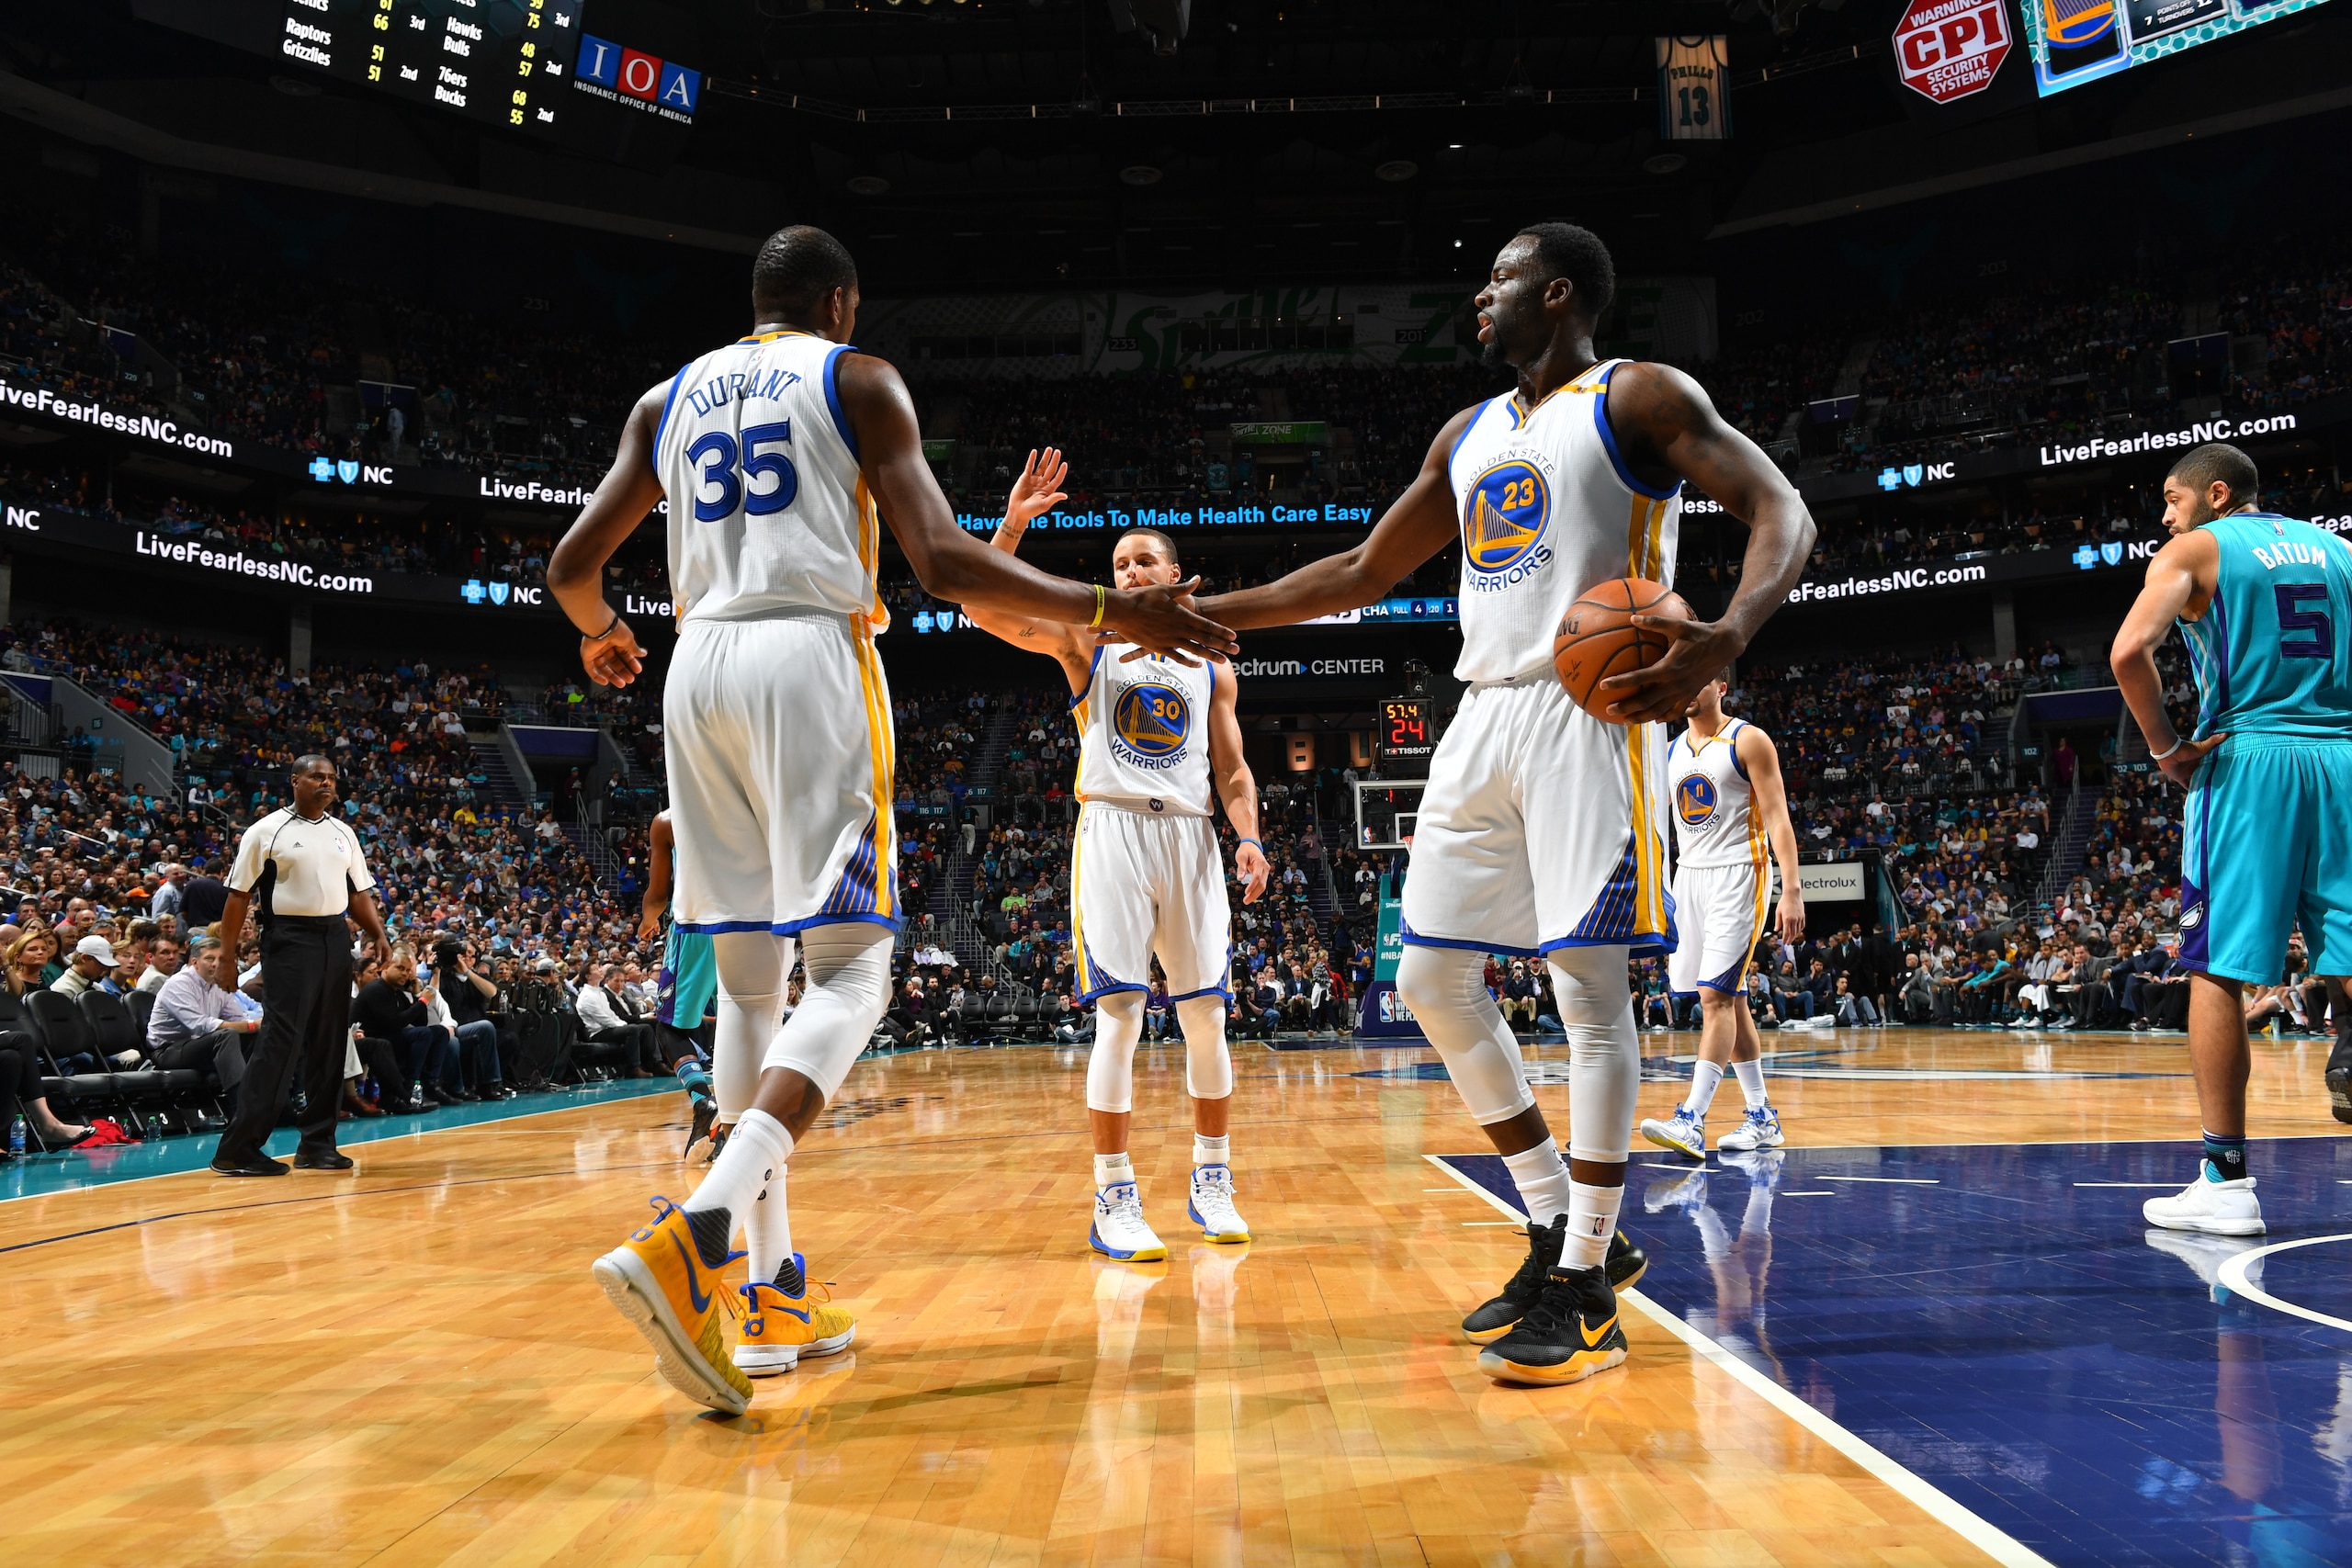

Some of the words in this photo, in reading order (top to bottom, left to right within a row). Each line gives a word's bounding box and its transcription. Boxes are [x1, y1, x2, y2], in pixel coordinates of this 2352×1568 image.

[2144, 16, 2153, 26] 7
[2157, 6, 2195, 24] TURNOVERS
[2156, 3, 2179, 16] POINTS
[286, 17, 332, 45] Raptors
[373, 14, 389, 30] 66
[410, 15, 425, 31] 3rd
[447, 17, 482, 40] Hawks
[527, 12, 540, 28] 75
[554, 13, 570, 28] 3rd
[443, 36, 470, 57] Bulls
[521, 41, 536, 58] 48
[1903, 6, 2003, 70] CPI
[283, 39, 331, 66] Grizzlies
[371, 45, 384, 62] 51
[368, 65, 381, 82] 51
[400, 65, 418, 81] 2nd
[438, 65, 468, 87] 76ers
[518, 61, 533, 77] 57
[545, 61, 562, 76] 2nd
[1670, 65, 1713, 80] PHILLS
[1927, 53, 1988, 85] SECURITY
[1931, 66, 1990, 96] SYSTEMS
[435, 85, 466, 107] Bucks
[512, 89, 527, 106] 68
[573, 80, 616, 101] INSURANCE
[619, 96, 646, 110] OFFICE
[648, 104, 658, 114] OF
[659, 107, 692, 125] AMERICA
[1679, 86, 1709, 126] 13
[510, 108, 524, 125] 55
[537, 107, 554, 123] 2nd
[1110, 338, 1137, 351] 233
[1397, 330, 1423, 343] 201
[686, 368, 802, 418] DURANT
[0, 379, 232, 457] iveFearlessNC.com
[1262, 425, 1293, 434] ZONE
[2041, 412, 2297, 467] LiveFearlessNC.com
[364, 466, 393, 484] NC
[685, 417, 797, 523] 35
[1464, 449, 1517, 492] GOLDEN
[1521, 448, 1555, 475] STATE
[1927, 462, 1955, 480] NC
[1501, 478, 1535, 511] 23
[6, 506, 40, 531] NC
[1051, 511, 1103, 528] Tools
[1107, 509, 1131, 527] To
[1136, 508, 1192, 526] Make
[1198, 505, 1265, 525] Health
[1271, 504, 1317, 523] Care
[1324, 502, 1373, 525] Easy
[2128, 539, 2159, 559] NC
[2252, 542, 2326, 570] BATUM
[136, 531, 373, 593] LiveFearlessNC.com
[1464, 544, 1553, 592] WARRIORS
[1783, 564, 1985, 604] eFearlessNC.com
[514, 586, 542, 605] NC
[626, 595, 676, 615] Live
[958, 614, 980, 628] N
[1363, 605, 1389, 616] CHA
[1394, 606, 1408, 615] FULL
[1415, 604, 1422, 614] 4
[1446, 604, 1453, 613] 1
[2274, 583, 2332, 659] 5
[1232, 659, 1300, 677] ectrum
[1311, 659, 1385, 674] CENTER
[1116, 674, 1161, 694] GOLDEN
[1166, 678, 1194, 705] STATE
[1152, 698, 1180, 720] 30
[1386, 704, 1418, 719] 57.4
[1391, 719, 1423, 744] 24
[1111, 738, 1188, 770] WARRIORS
[1674, 768, 1698, 787] GOLDEN
[2133, 763, 2147, 772] 103
[1696, 784, 1703, 797] 11
[1680, 813, 1720, 834] WARRIORS
[1801, 877, 1857, 889] lectrolux
